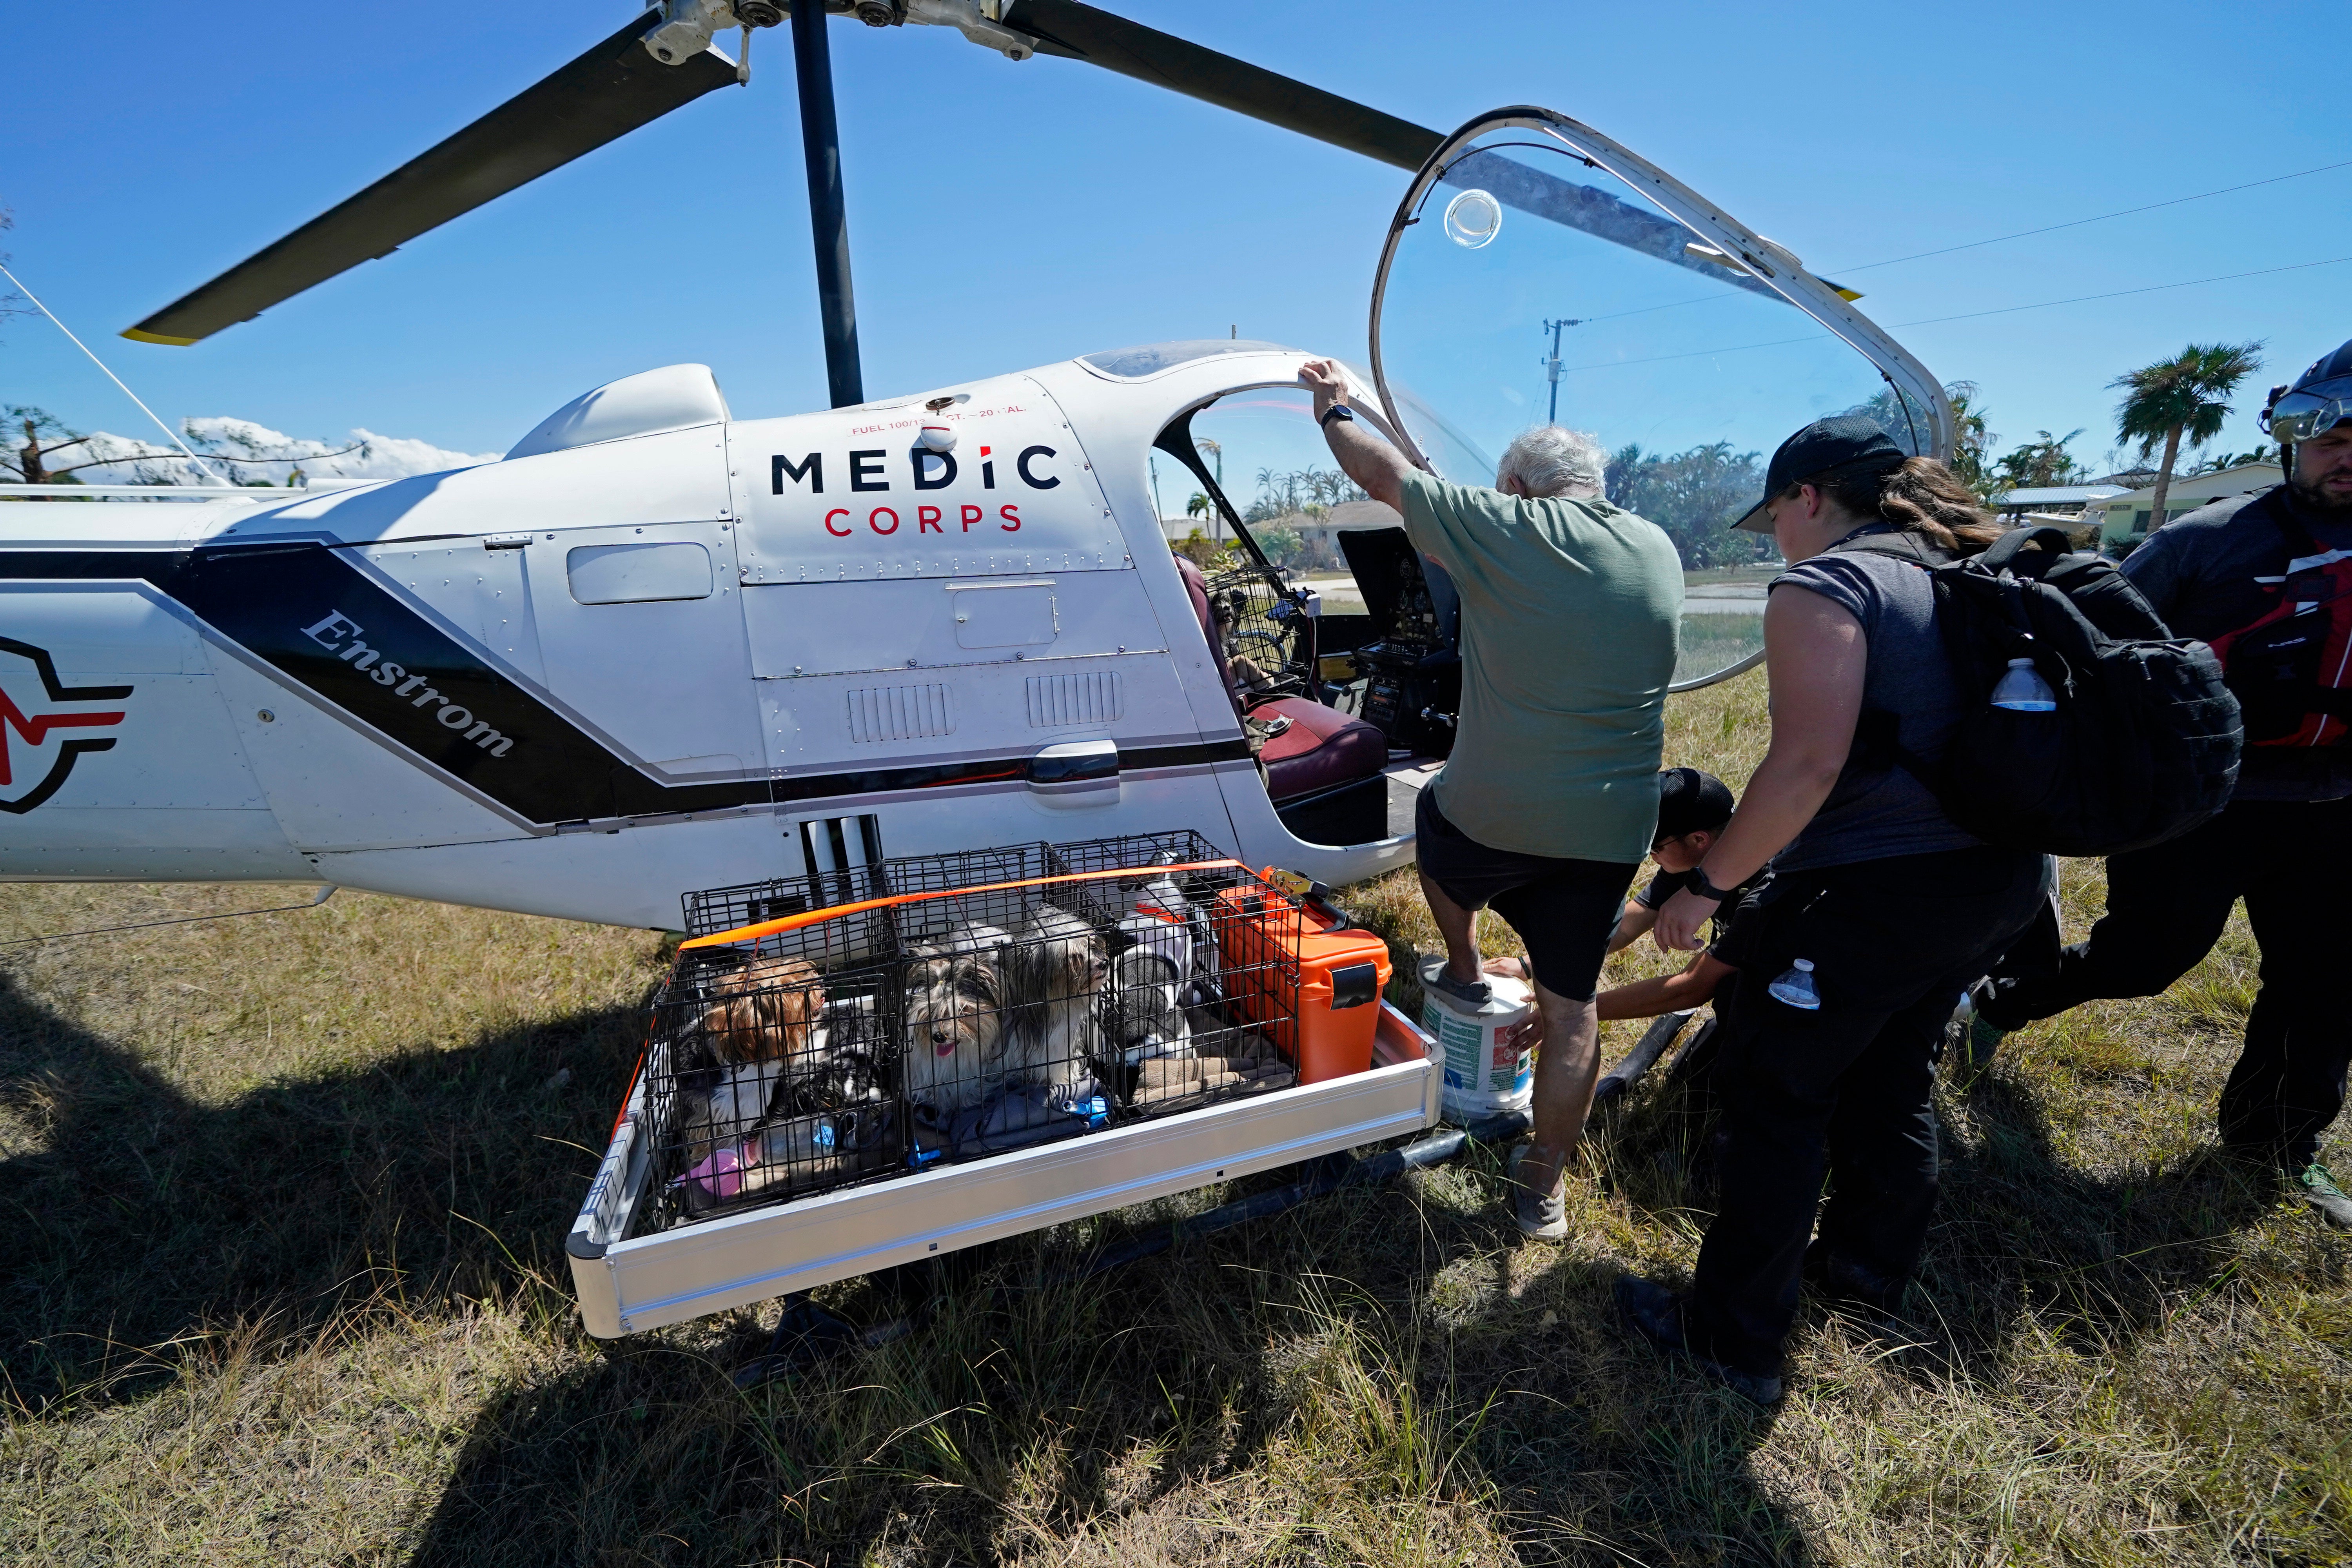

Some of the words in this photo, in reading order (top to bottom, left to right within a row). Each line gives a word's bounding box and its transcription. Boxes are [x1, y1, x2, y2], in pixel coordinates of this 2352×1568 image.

[852, 425, 885, 434] FUEL
[889, 419, 926, 429] 100/13
[825, 504, 1022, 537] CORPS
[2268, 637, 2306, 648] NRS
[300, 609, 514, 757] Enstrom
